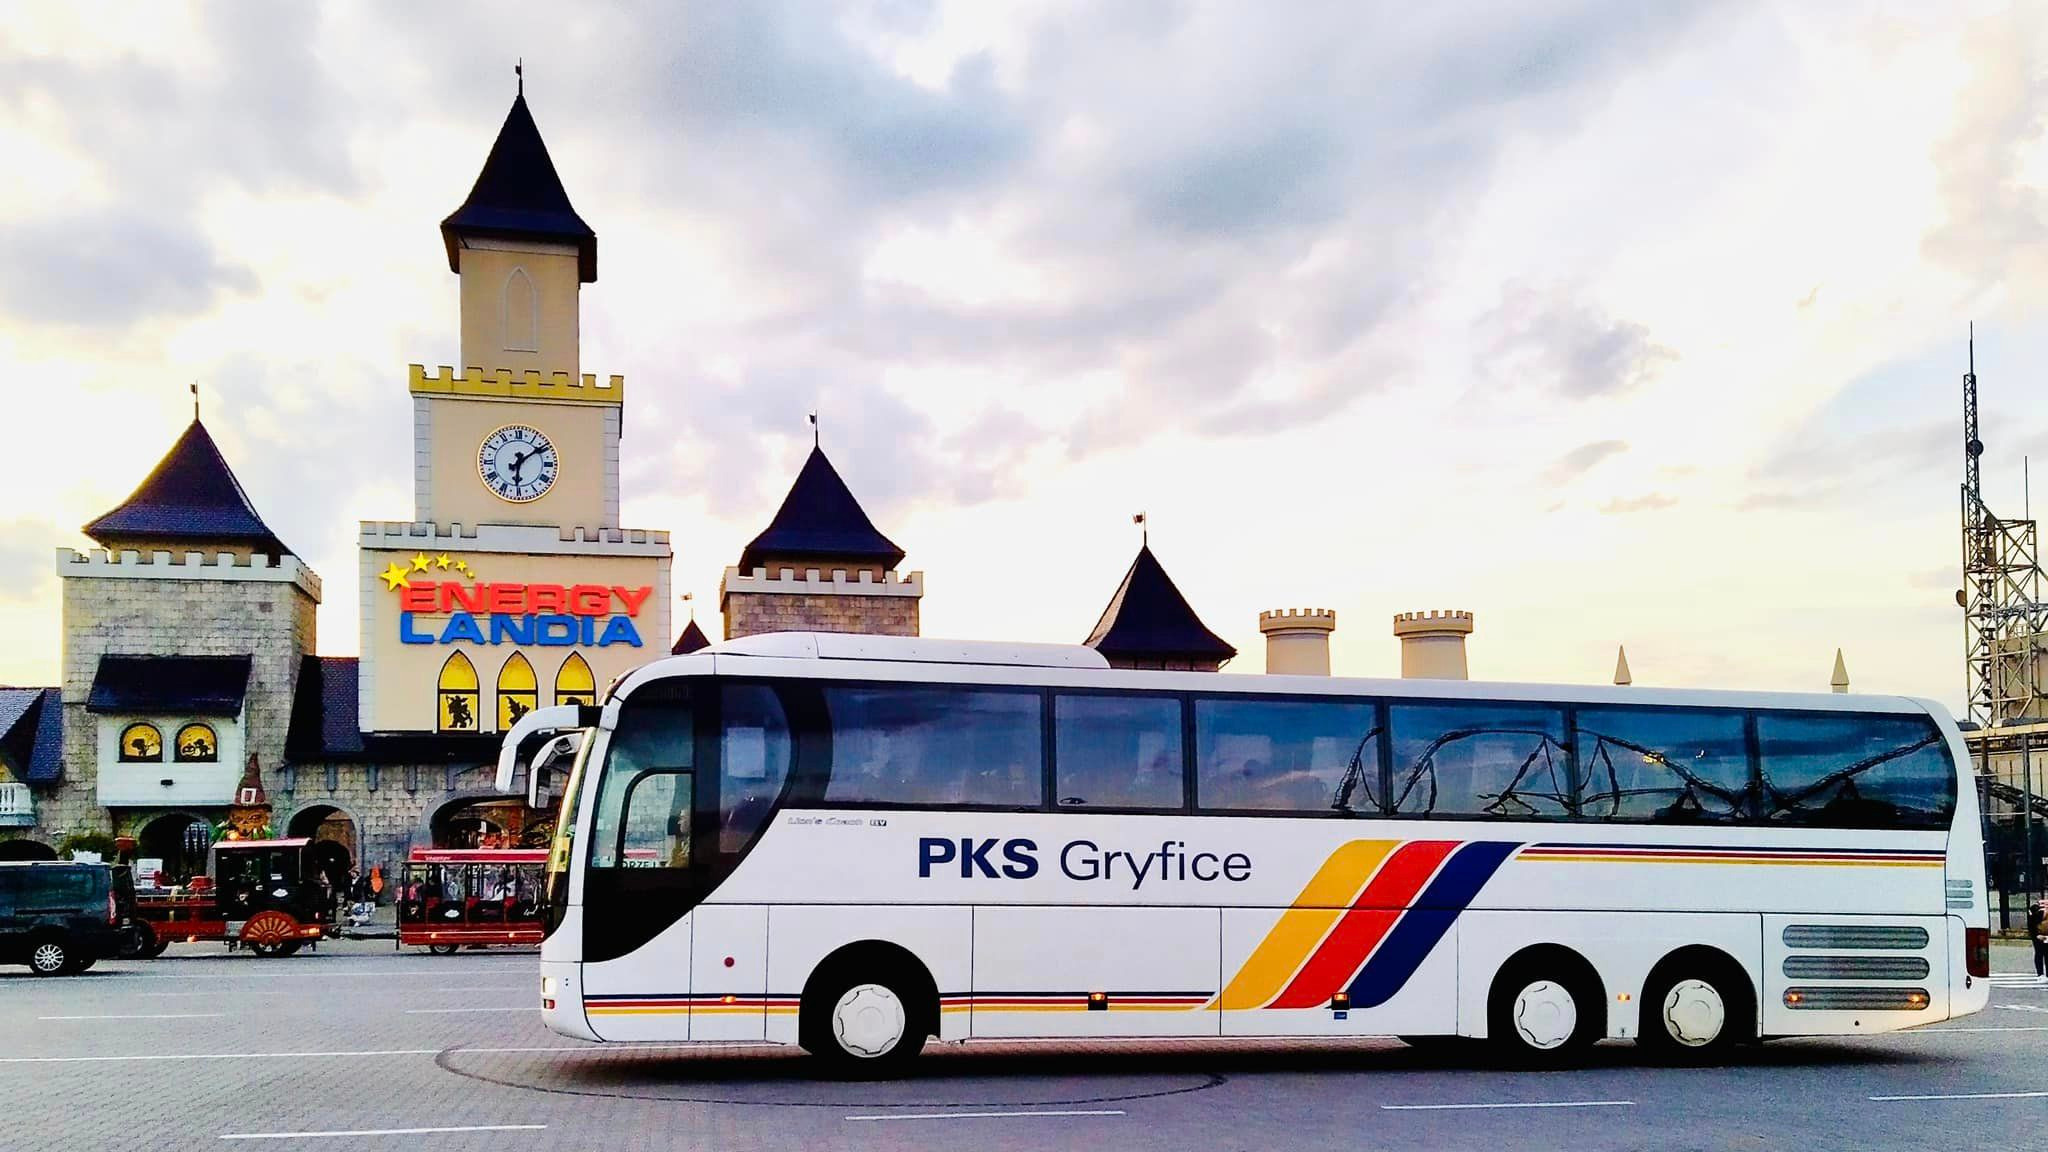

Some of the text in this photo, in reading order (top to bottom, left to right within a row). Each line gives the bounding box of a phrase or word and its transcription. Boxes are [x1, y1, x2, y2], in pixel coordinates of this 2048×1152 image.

[400, 581, 653, 617] ENERGY
[400, 611, 643, 647] LANDIA
[918, 837, 1252, 890] PKS Gryfice
